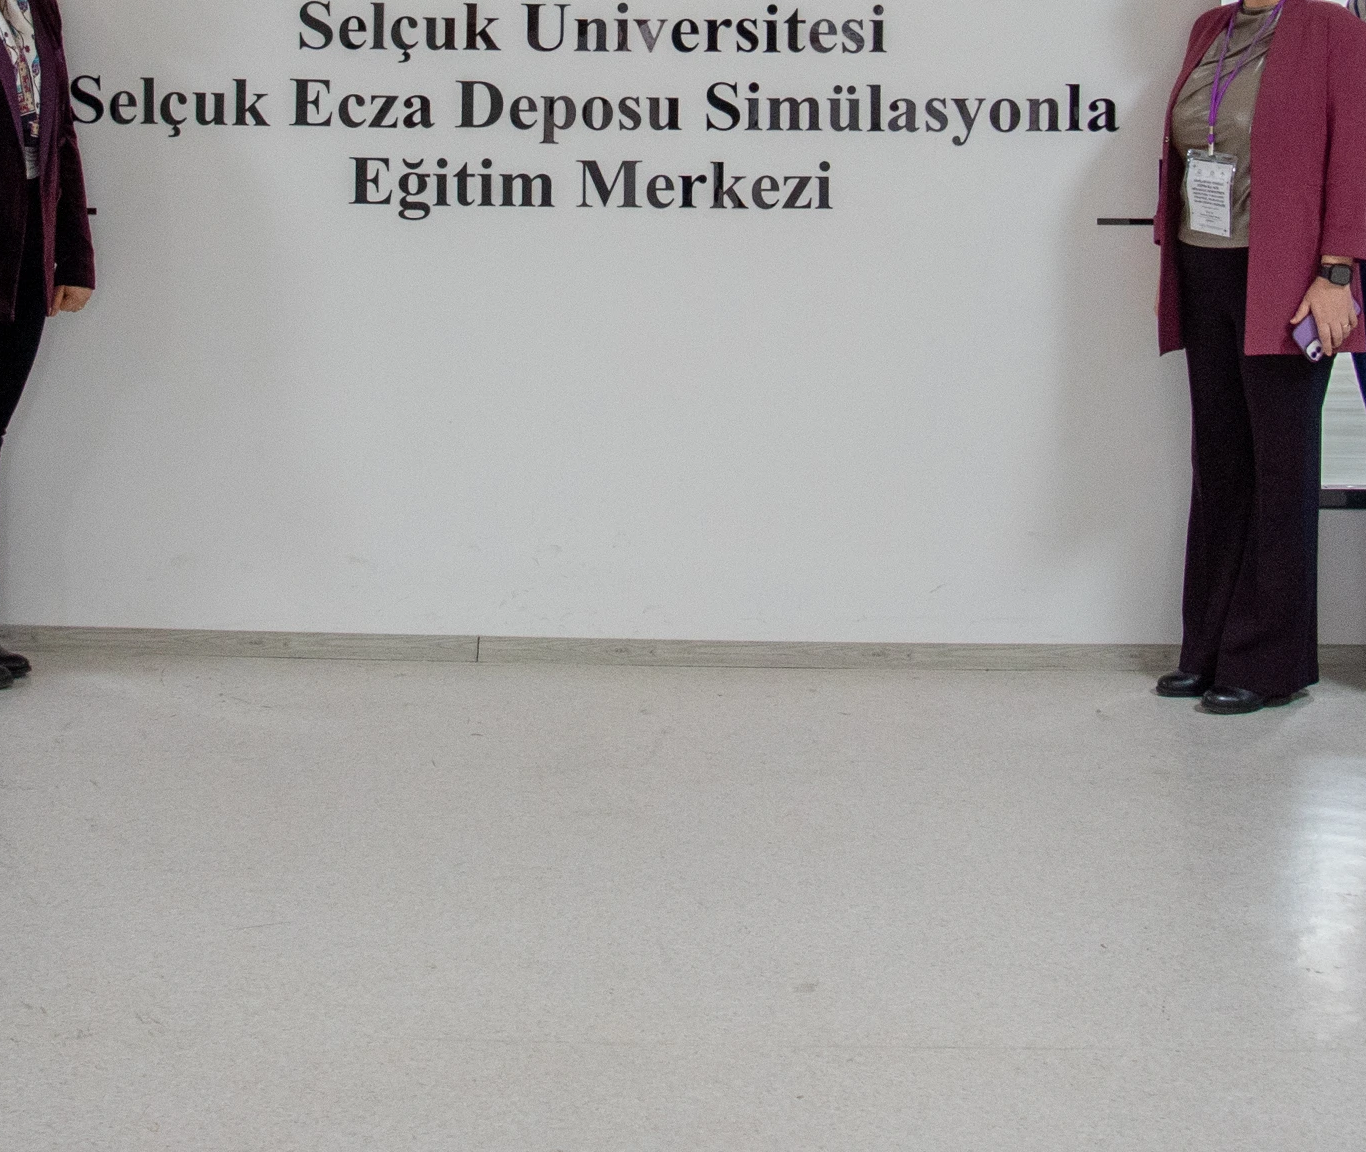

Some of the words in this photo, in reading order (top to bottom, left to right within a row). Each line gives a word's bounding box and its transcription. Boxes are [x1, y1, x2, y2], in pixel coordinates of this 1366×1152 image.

[299, 0, 502, 64] Selçuk
[70, 74, 271, 138] Selçuk
[288, 78, 435, 129] Ecza
[454, 80, 682, 145] Deposu
[706, 81, 1120, 146] Simülasyonla
[349, 156, 555, 221] Eğitim
[576, 160, 833, 210] Merkezi
